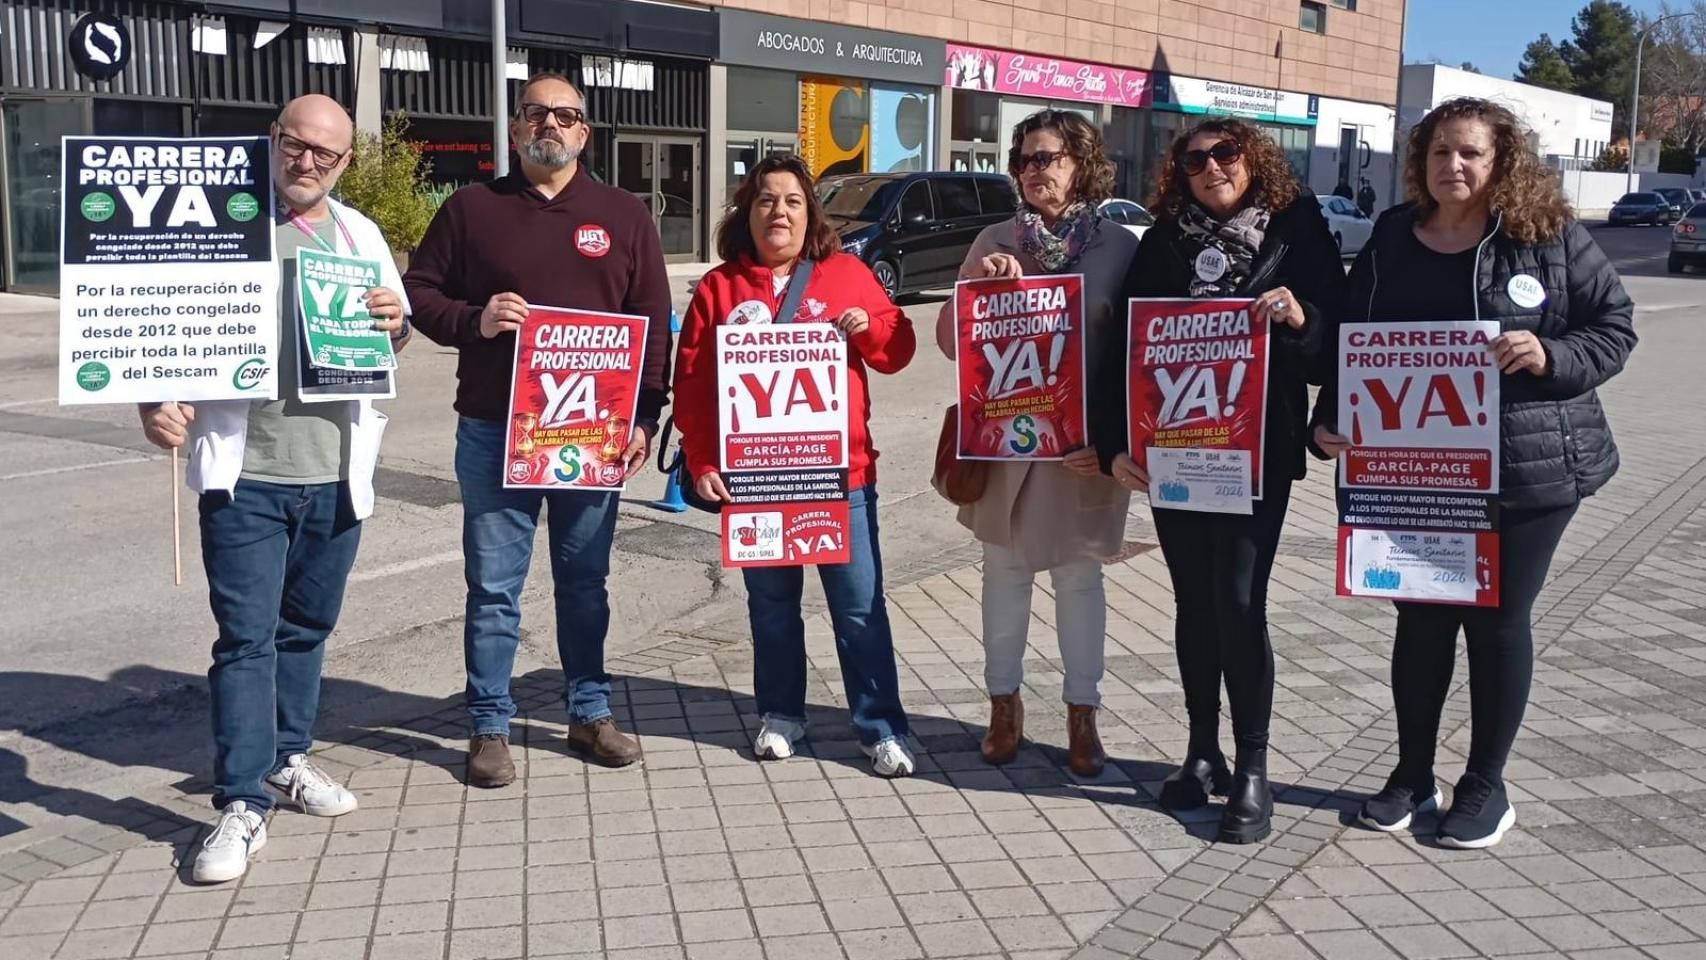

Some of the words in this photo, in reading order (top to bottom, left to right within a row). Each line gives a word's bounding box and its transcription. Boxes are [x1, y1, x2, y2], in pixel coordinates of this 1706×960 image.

[757, 31, 825, 55] ABOGADOS
[836, 41, 844, 57] &
[852, 43, 923, 67] ARQUITECTURA
[1206, 81, 1229, 94] Gerencia
[82, 145, 251, 168] CARRERA
[80, 169, 254, 185] PROFESIONAL
[118, 185, 217, 227] YA
[304, 258, 376, 279] CARRERA
[76, 284, 106, 297] Por
[111, 284, 125, 297] la
[130, 282, 238, 297] recuperación
[243, 281, 262, 294] de
[305, 278, 370, 318] YA
[972, 286, 1067, 320] CARRERA
[77, 306, 98, 317] un
[103, 304, 171, 317] derecho
[176, 302, 262, 318] congelado
[82, 326, 133, 338] desde
[138, 324, 176, 337] 2012
[181, 326, 212, 338] que
[217, 322, 257, 335] debe
[971, 312, 1072, 341] PROFESIONAL
[1146, 309, 1250, 342] CARRERA
[535, 324, 630, 349] CARRERA
[725, 330, 840, 346] CARRERA
[1348, 330, 1490, 347] CARRERA
[72, 346, 137, 362] percibir
[142, 345, 178, 358] toda
[183, 344, 197, 357] la
[203, 343, 267, 358] plantilla
[724, 348, 841, 364] PROFESIONAL
[1144, 339, 1255, 365] PROFESIONAL
[1346, 351, 1492, 368] PROFESIONAL
[530, 351, 632, 370] PROFESIONAL
[982, 333, 1065, 399] YA!
[122, 367, 147, 379] del
[153, 366, 218, 378] Sescam
[240, 367, 270, 380] CSIF
[539, 372, 610, 427] YA.
[728, 365, 839, 433] ¡YA!
[1153, 360, 1247, 428] YA!
[1350, 370, 1487, 445] ¡YA!
[743, 444, 827, 456] GARCÍA-PAGE
[1388, 451, 1409, 459] HORA
[1410, 451, 1419, 459] DE
[1446, 452, 1487, 460] PRESIDENTE
[734, 458, 769, 467] CUMPLA
[771, 457, 787, 466] SUS
[788, 456, 833, 465] PROMESAS
[1367, 460, 1471, 474] GARCÍA-PAGE
[801, 472, 840, 480] RECOMPENSA
[1356, 474, 1398, 484] CUMPLA
[1400, 475, 1420, 485] SUS
[1421, 476, 1478, 487] PROMESAS
[736, 485, 747, 493] LOS
[747, 484, 794, 493] PROFESIONALES
[1215, 485, 1243, 497] 2026
[1349, 493, 1379, 501] PORQUE
[1380, 494, 1392, 502] NO
[1393, 494, 1408, 502] HAY
[1409, 495, 1436, 503] MAYOR
[1437, 496, 1488, 506] RECOMPENSA
[791, 511, 831, 524] CARRERA
[1349, 504, 1356, 512] A
[1371, 505, 1429, 515] PROFESIONALES
[1430, 507, 1439, 515] DE
[1441, 508, 1450, 516] LA
[785, 519, 842, 537] PROFESIONAL
[787, 532, 844, 561] ¡YA!
[1433, 571, 1466, 583] 2026
